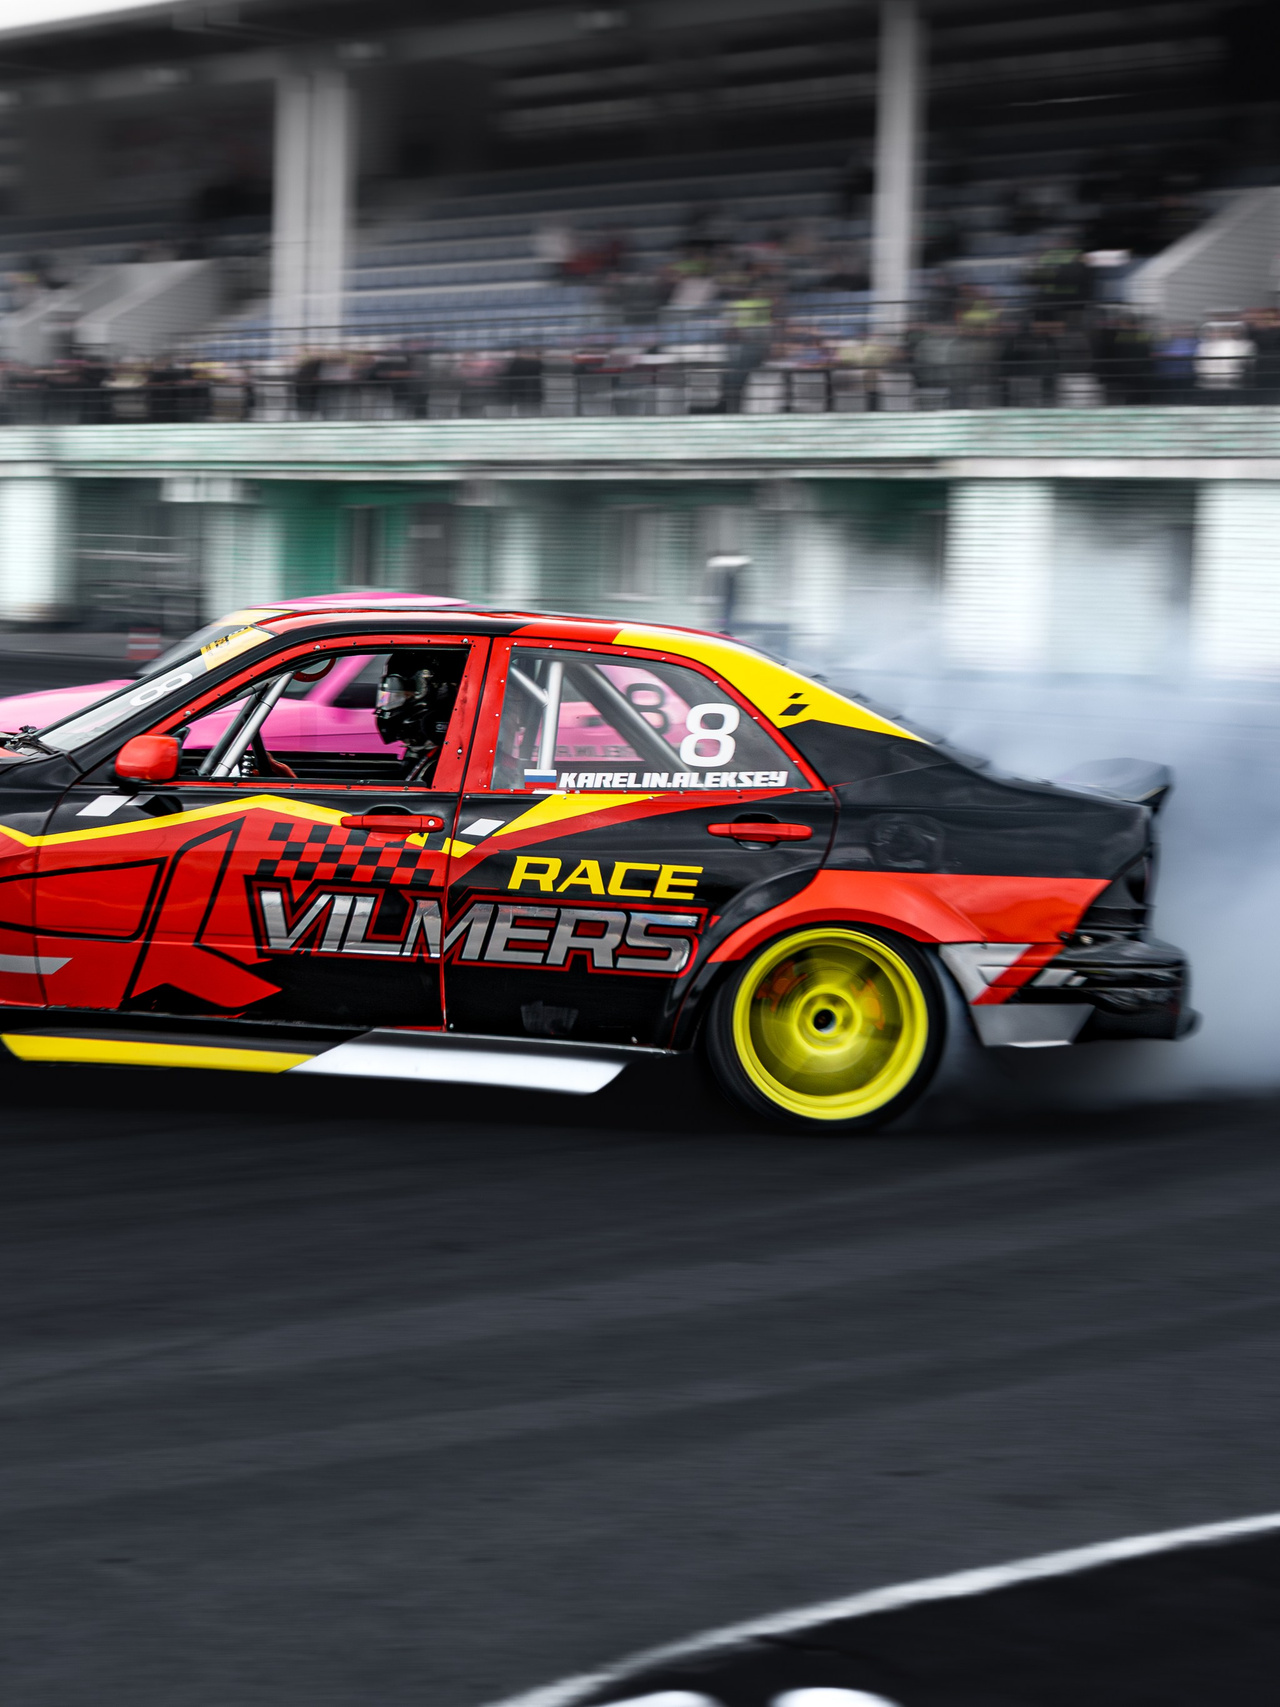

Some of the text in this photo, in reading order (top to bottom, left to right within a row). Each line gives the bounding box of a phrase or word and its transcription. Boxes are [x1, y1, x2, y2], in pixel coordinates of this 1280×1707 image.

[129, 672, 193, 707] 8
[679, 703, 740, 767] 8
[558, 771, 788, 788] KARELIN.ALEKSEY
[507, 855, 704, 900] RACE
[259, 889, 699, 973] VILMERS
